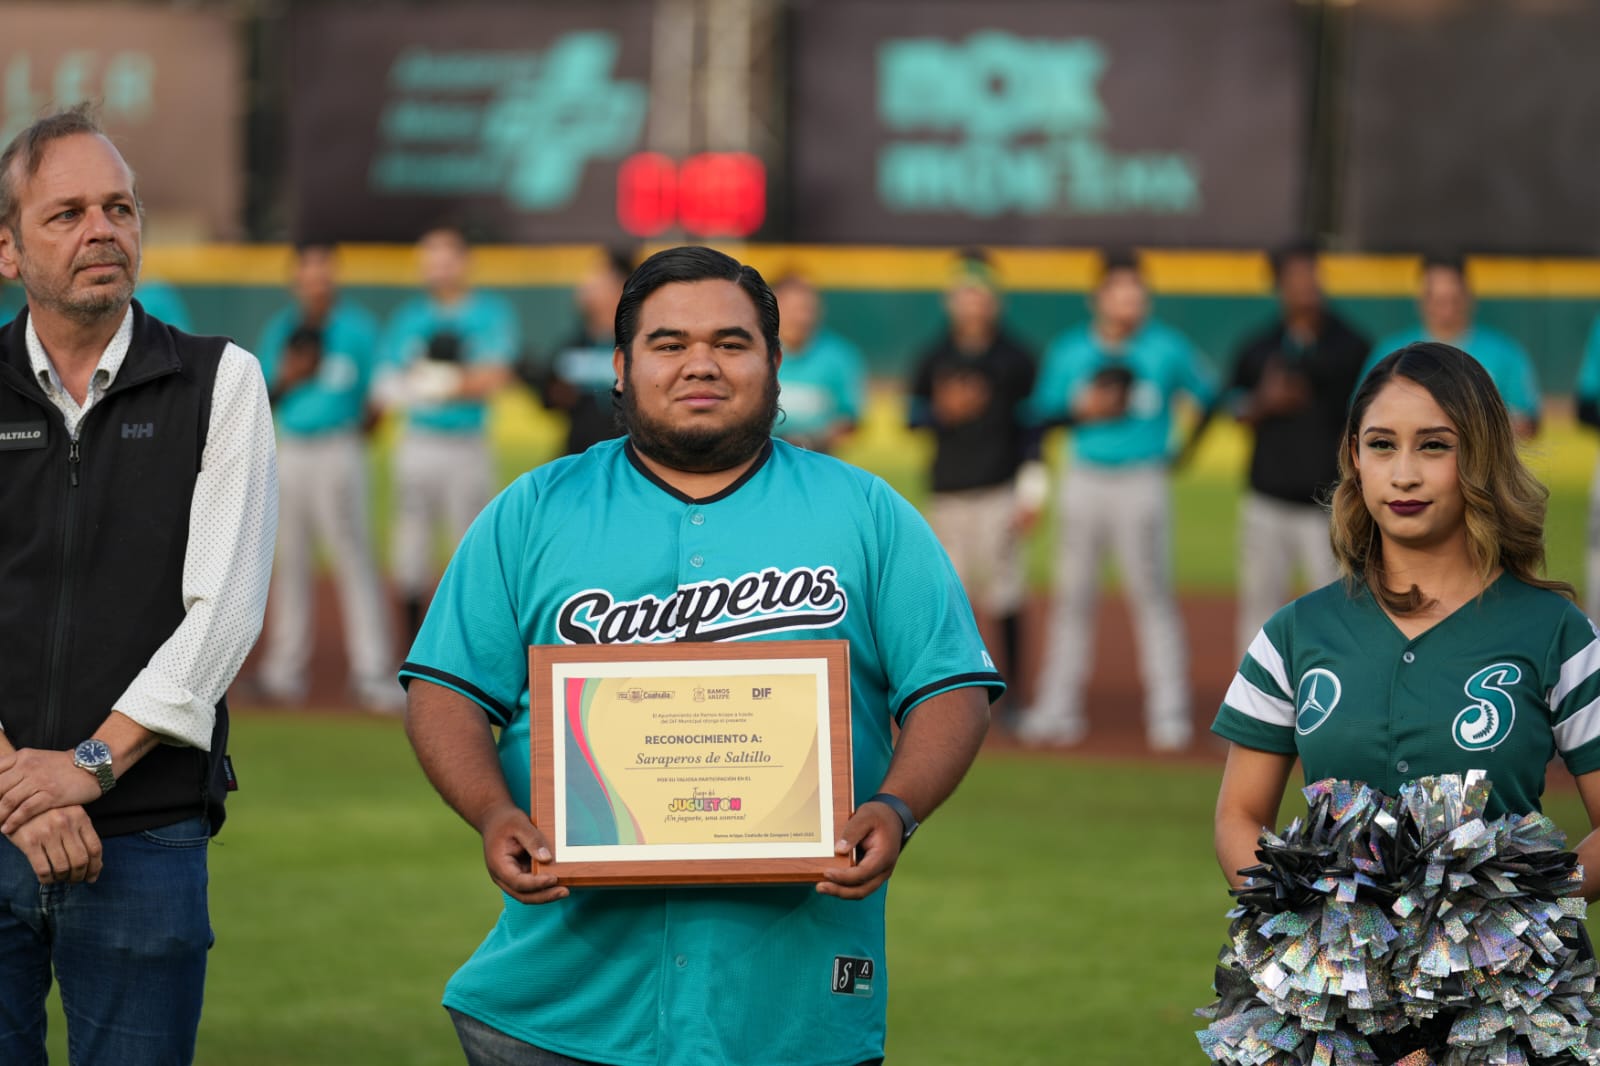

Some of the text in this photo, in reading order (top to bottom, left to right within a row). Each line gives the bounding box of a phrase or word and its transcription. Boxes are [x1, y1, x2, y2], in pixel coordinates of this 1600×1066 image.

[121, 422, 154, 439] HH
[557, 564, 849, 645] Saraperos
[752, 687, 772, 698] DIF
[1452, 662, 1522, 751] S
[645, 733, 763, 745] RECONOCIMIENTO A:
[635, 750, 771, 768] Saraperos de Saltillo
